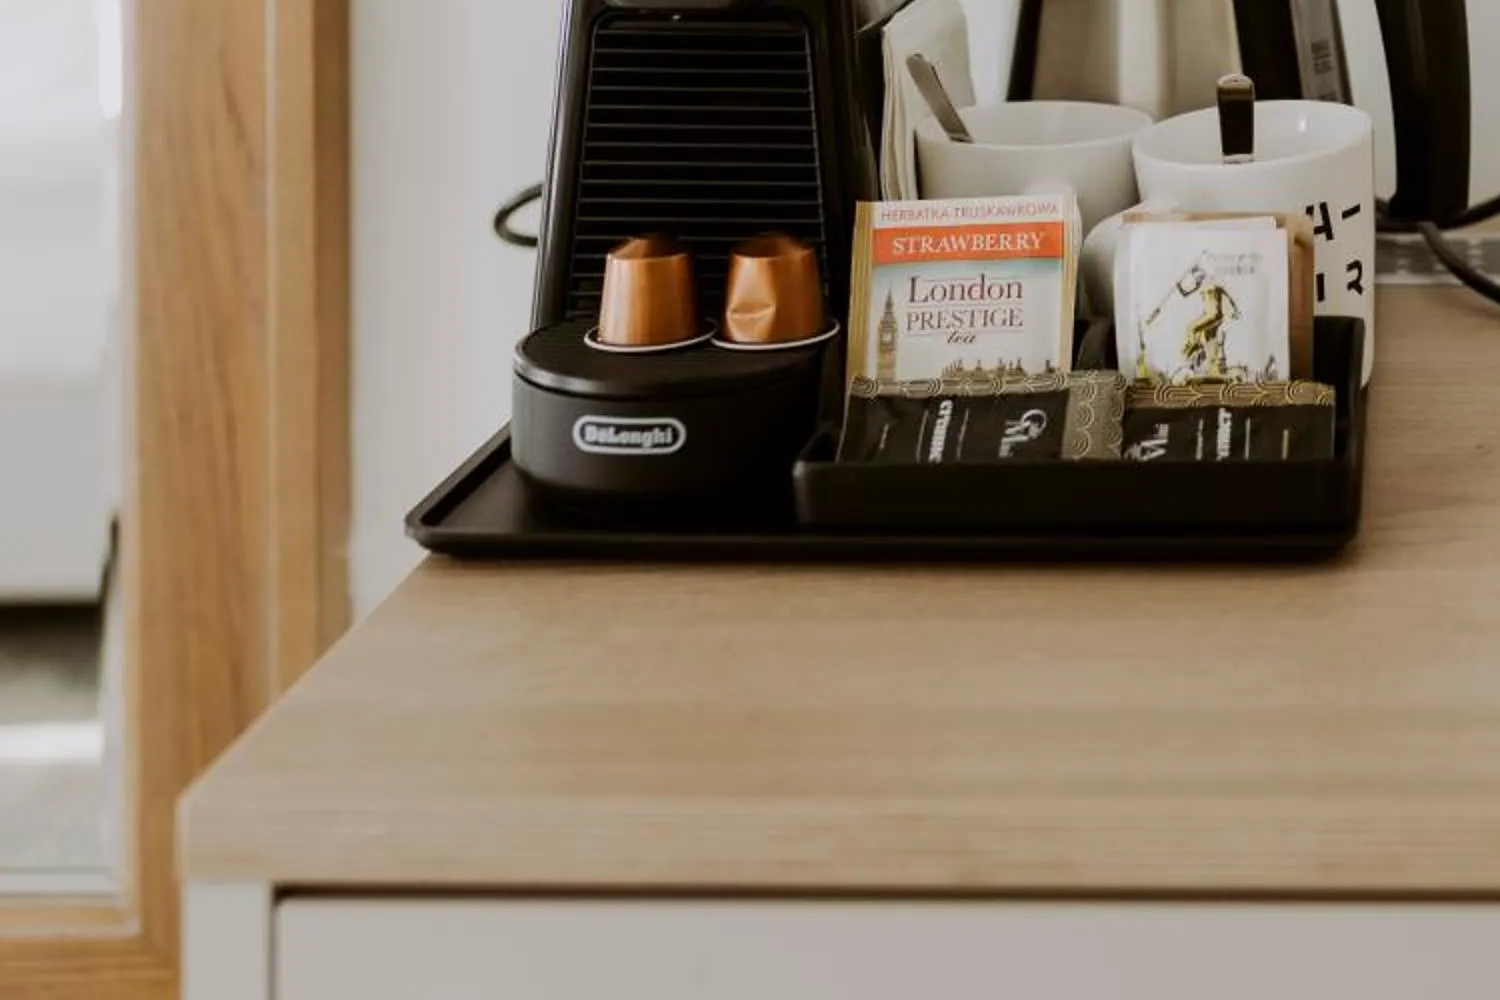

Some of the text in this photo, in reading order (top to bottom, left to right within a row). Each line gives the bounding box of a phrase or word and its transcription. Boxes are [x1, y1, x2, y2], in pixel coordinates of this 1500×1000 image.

[892, 231, 1045, 255] STRAWBERRY
[909, 273, 1023, 303] London
[906, 307, 1023, 332] PRESTIGE
[946, 330, 977, 345] tea
